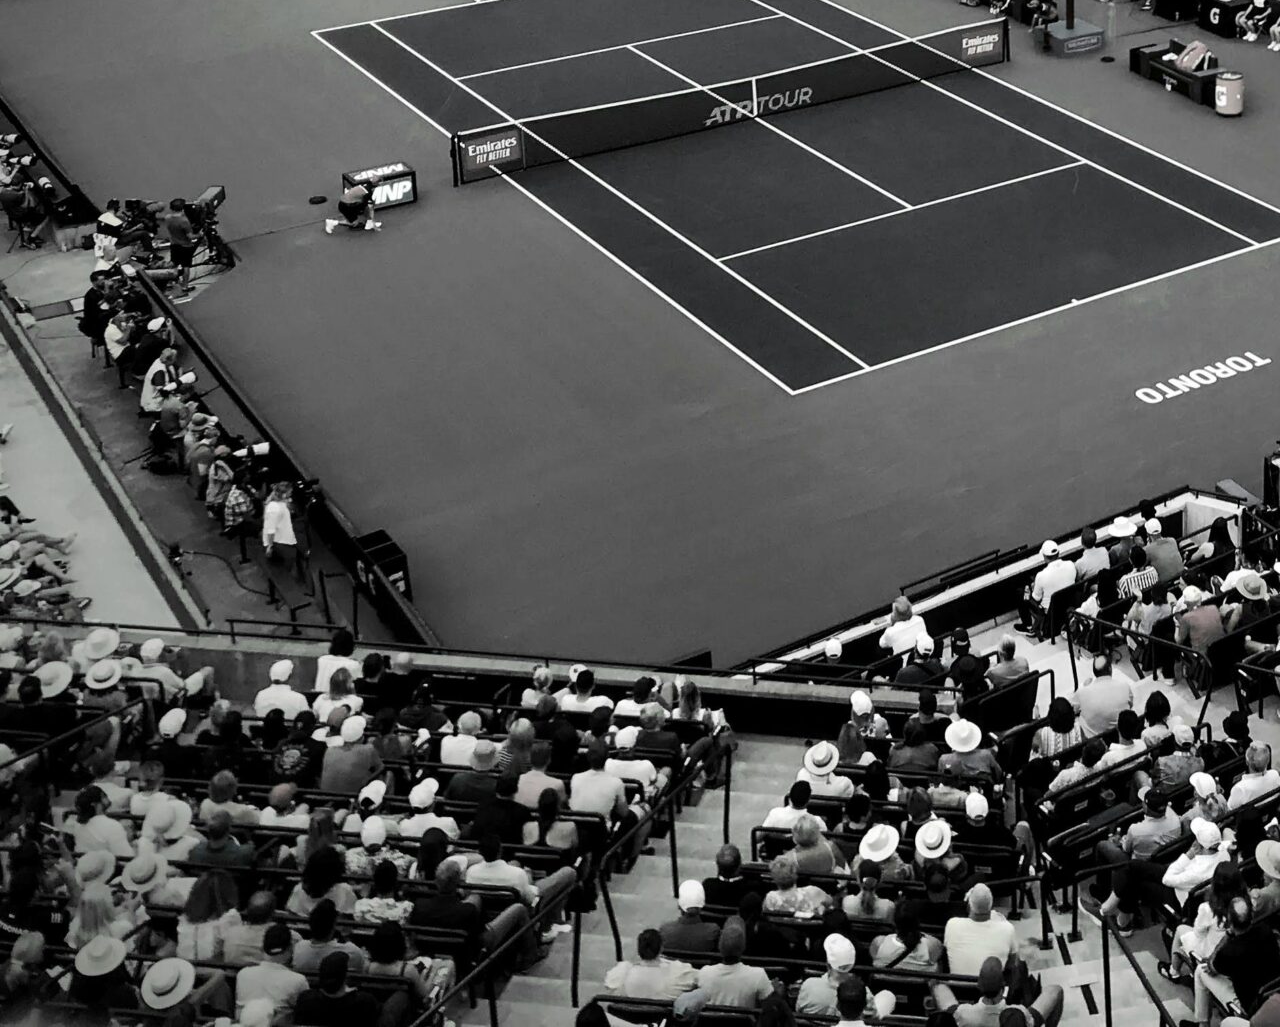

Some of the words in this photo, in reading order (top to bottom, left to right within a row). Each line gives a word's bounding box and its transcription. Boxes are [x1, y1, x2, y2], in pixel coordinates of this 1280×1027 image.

[1209, 7, 1221, 25] G
[962, 34, 999, 48] Emirates
[703, 100, 752, 127] ATP
[757, 87, 813, 114] TOUR
[468, 137, 517, 157] Emirates
[476, 154, 488, 165] FLY
[488, 148, 511, 161] BETTER
[353, 162, 404, 181] MNP
[1135, 351, 1272, 404] TORONTO
